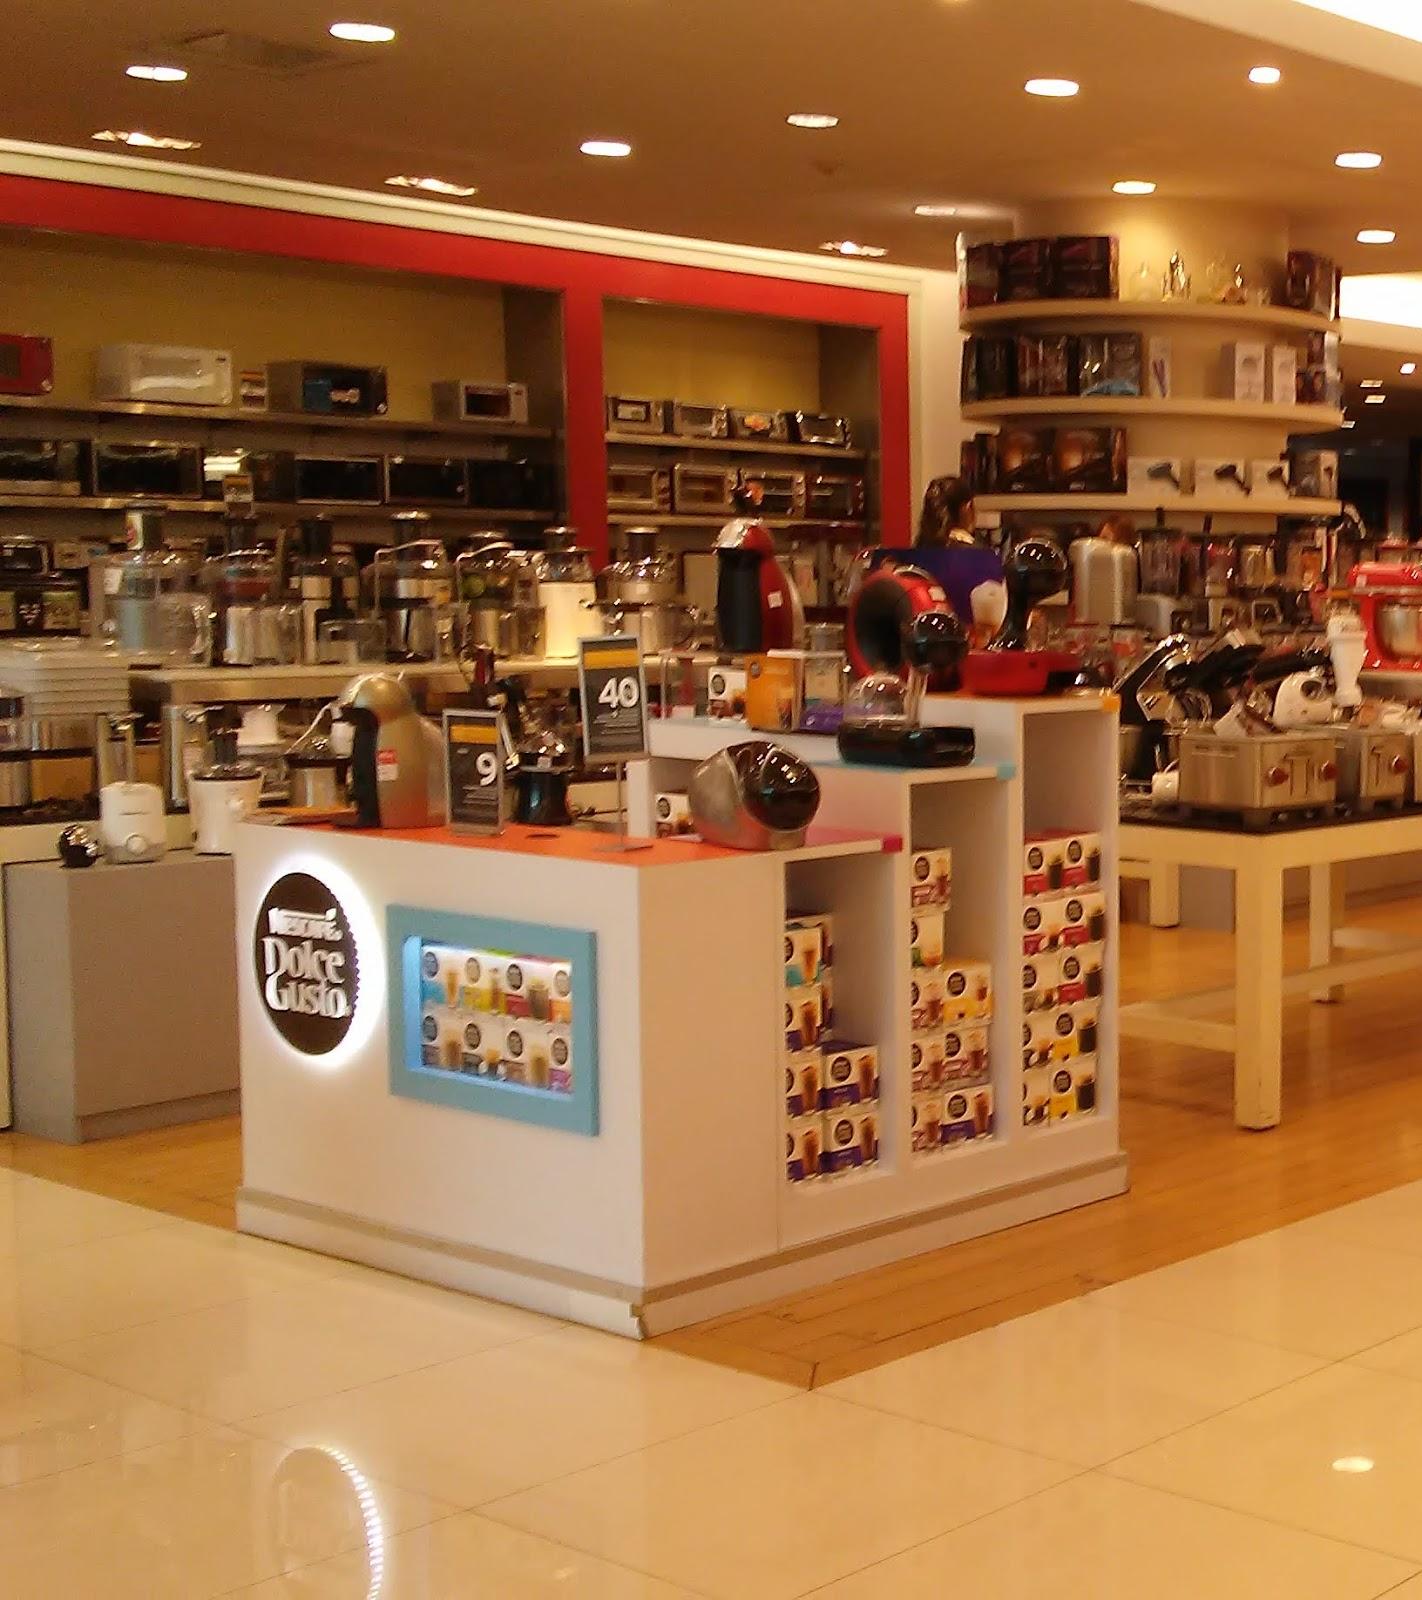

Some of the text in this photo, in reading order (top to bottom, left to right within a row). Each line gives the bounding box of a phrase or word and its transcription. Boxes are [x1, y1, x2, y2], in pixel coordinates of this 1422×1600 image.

[598, 676, 640, 709] 40
[475, 751, 498, 787] 9
[260, 936, 347, 984] Dolce
